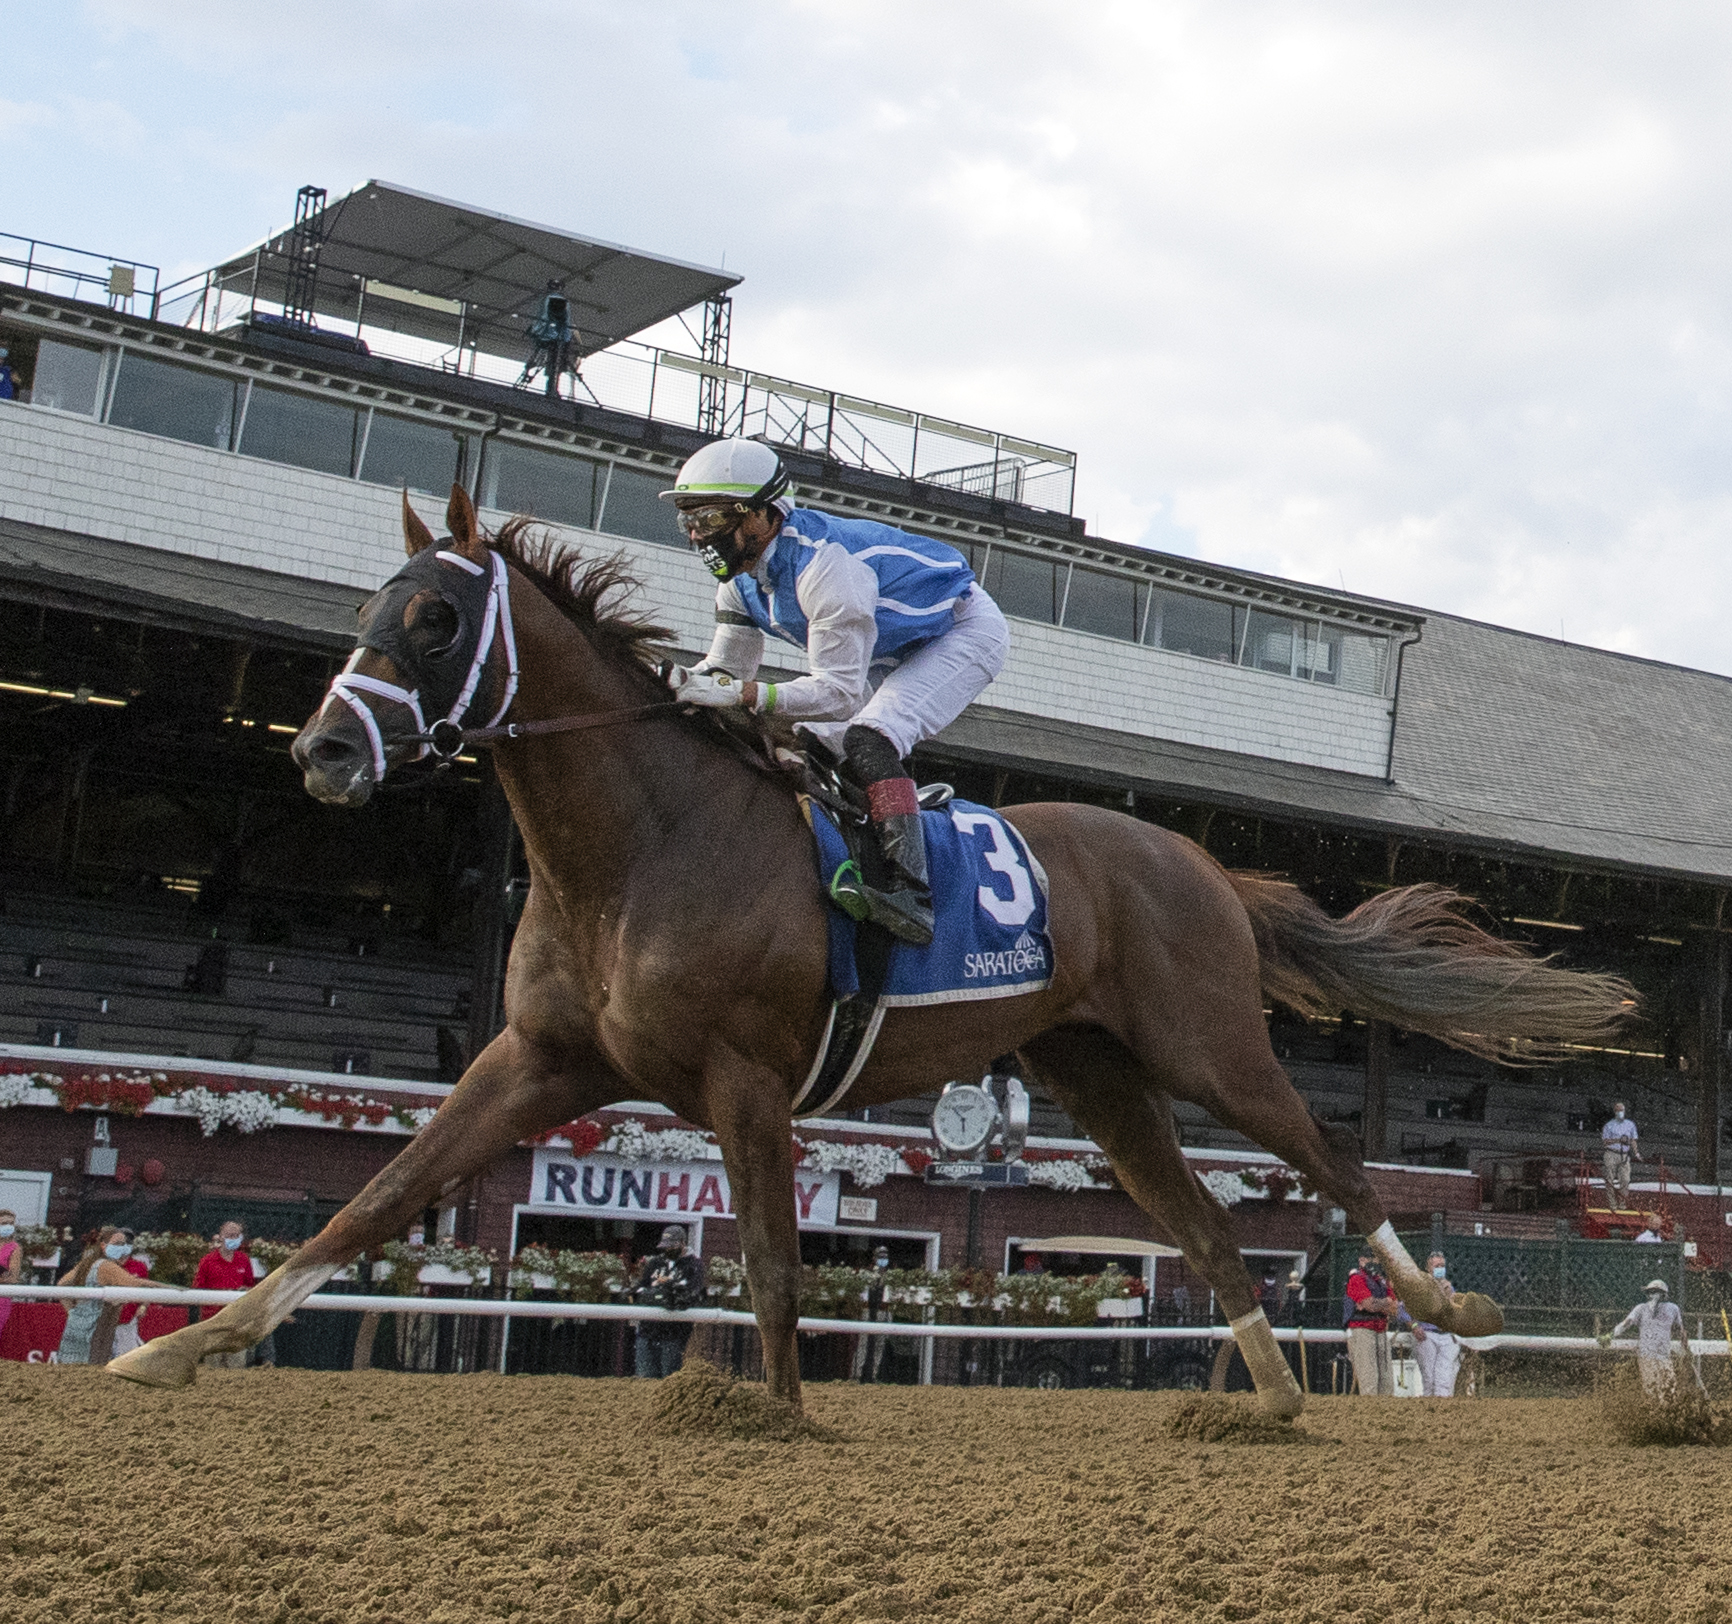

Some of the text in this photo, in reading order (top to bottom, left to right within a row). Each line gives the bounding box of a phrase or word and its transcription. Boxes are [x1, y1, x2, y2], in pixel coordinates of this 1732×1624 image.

[951, 809, 1036, 926] 3
[964, 946, 1046, 978] SARATOGA
[545, 1161, 822, 1219] RUNHAY
